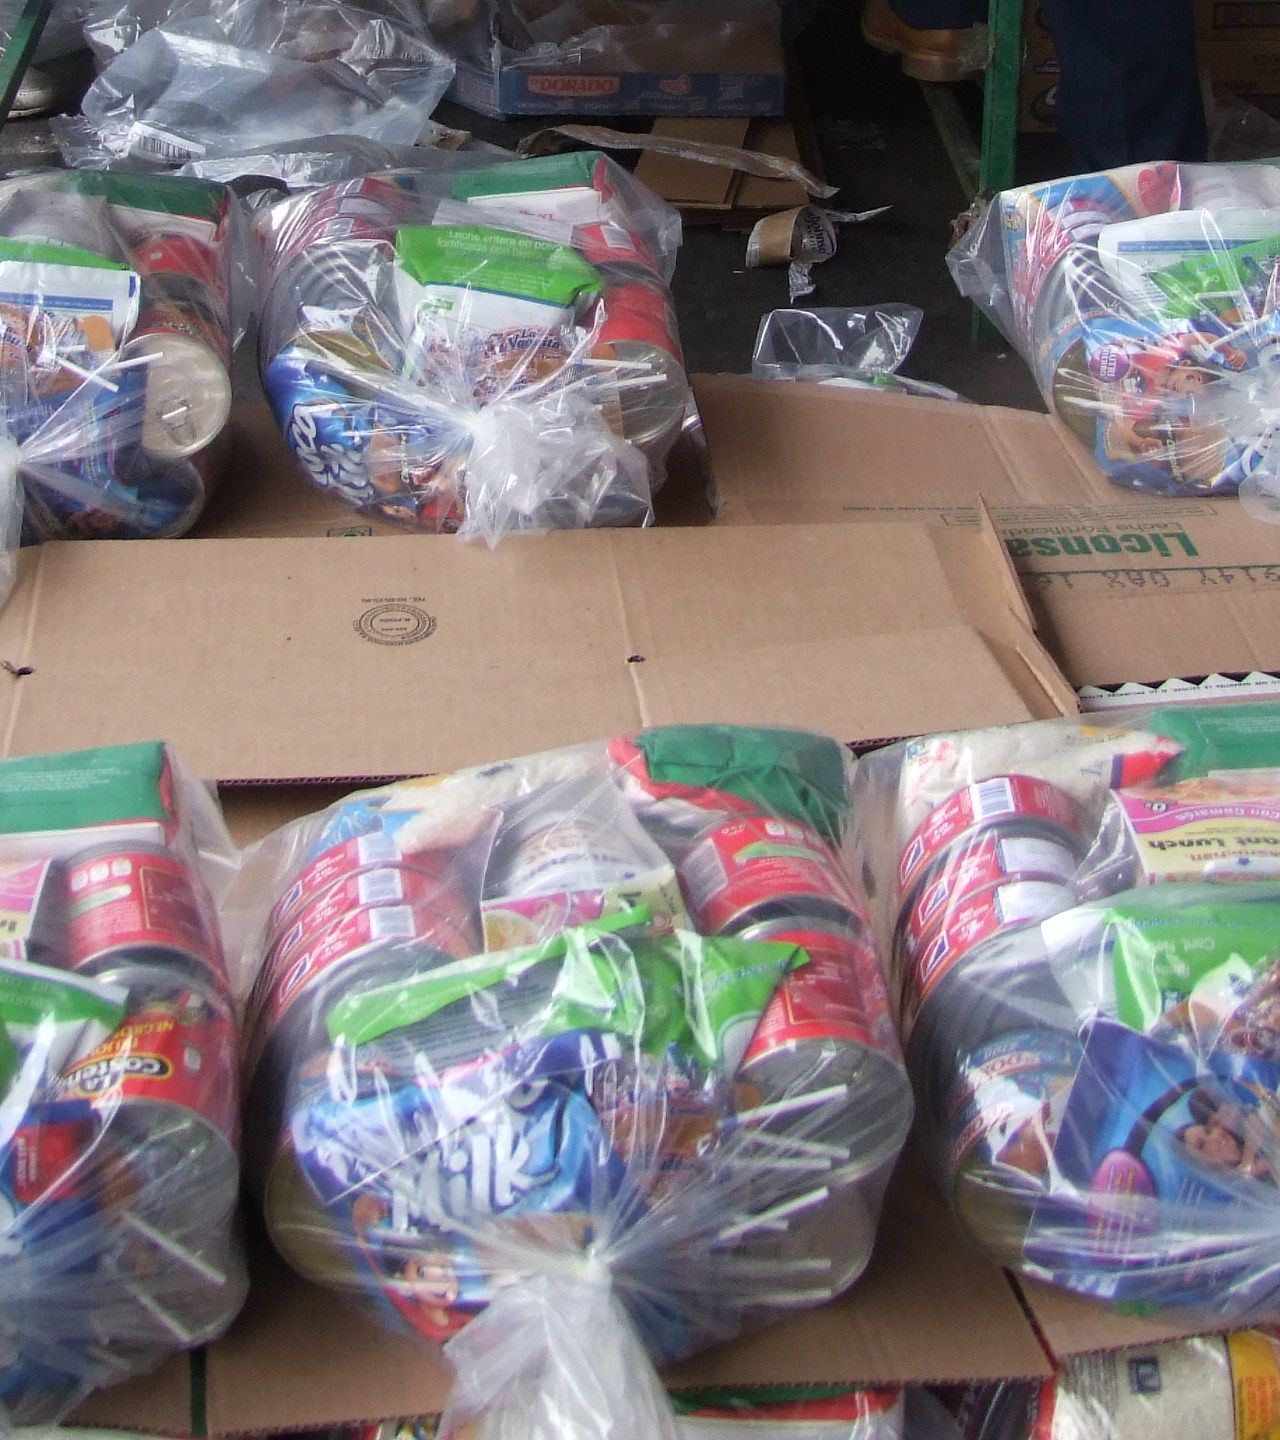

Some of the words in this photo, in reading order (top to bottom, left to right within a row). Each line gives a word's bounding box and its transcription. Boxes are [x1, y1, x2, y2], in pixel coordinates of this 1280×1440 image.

[540, 77, 613, 92] DORADO
[1069, 523, 1111, 535] Leche
[1004, 530, 1200, 557] Liconsa
[1106, 570, 1171, 587] OAX
[1148, 836, 1226, 852] Lunch
